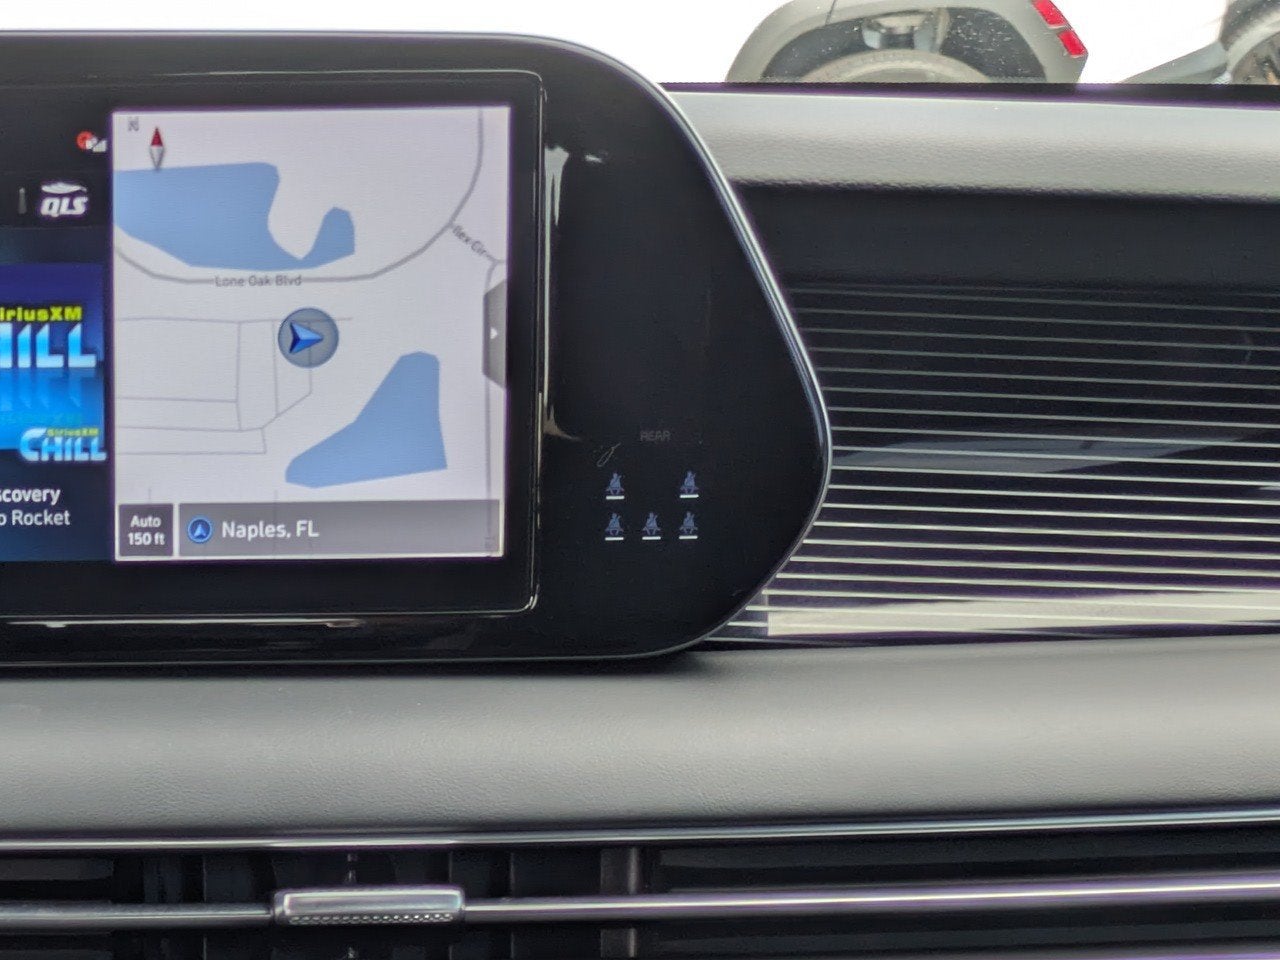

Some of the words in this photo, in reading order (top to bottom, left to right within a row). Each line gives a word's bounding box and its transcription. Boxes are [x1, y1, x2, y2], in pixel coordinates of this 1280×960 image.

[215, 276, 244, 287] Lone
[249, 275, 271, 287] Oak
[276, 275, 302, 287] Blvd
[640, 430, 671, 442] REAR
[12, 509, 71, 526] Rocket
[130, 515, 161, 528] Auto
[222, 520, 291, 541] Naples,
[296, 520, 319, 537] FL
[128, 532, 152, 546] 150
[154, 532, 165, 546] ft
